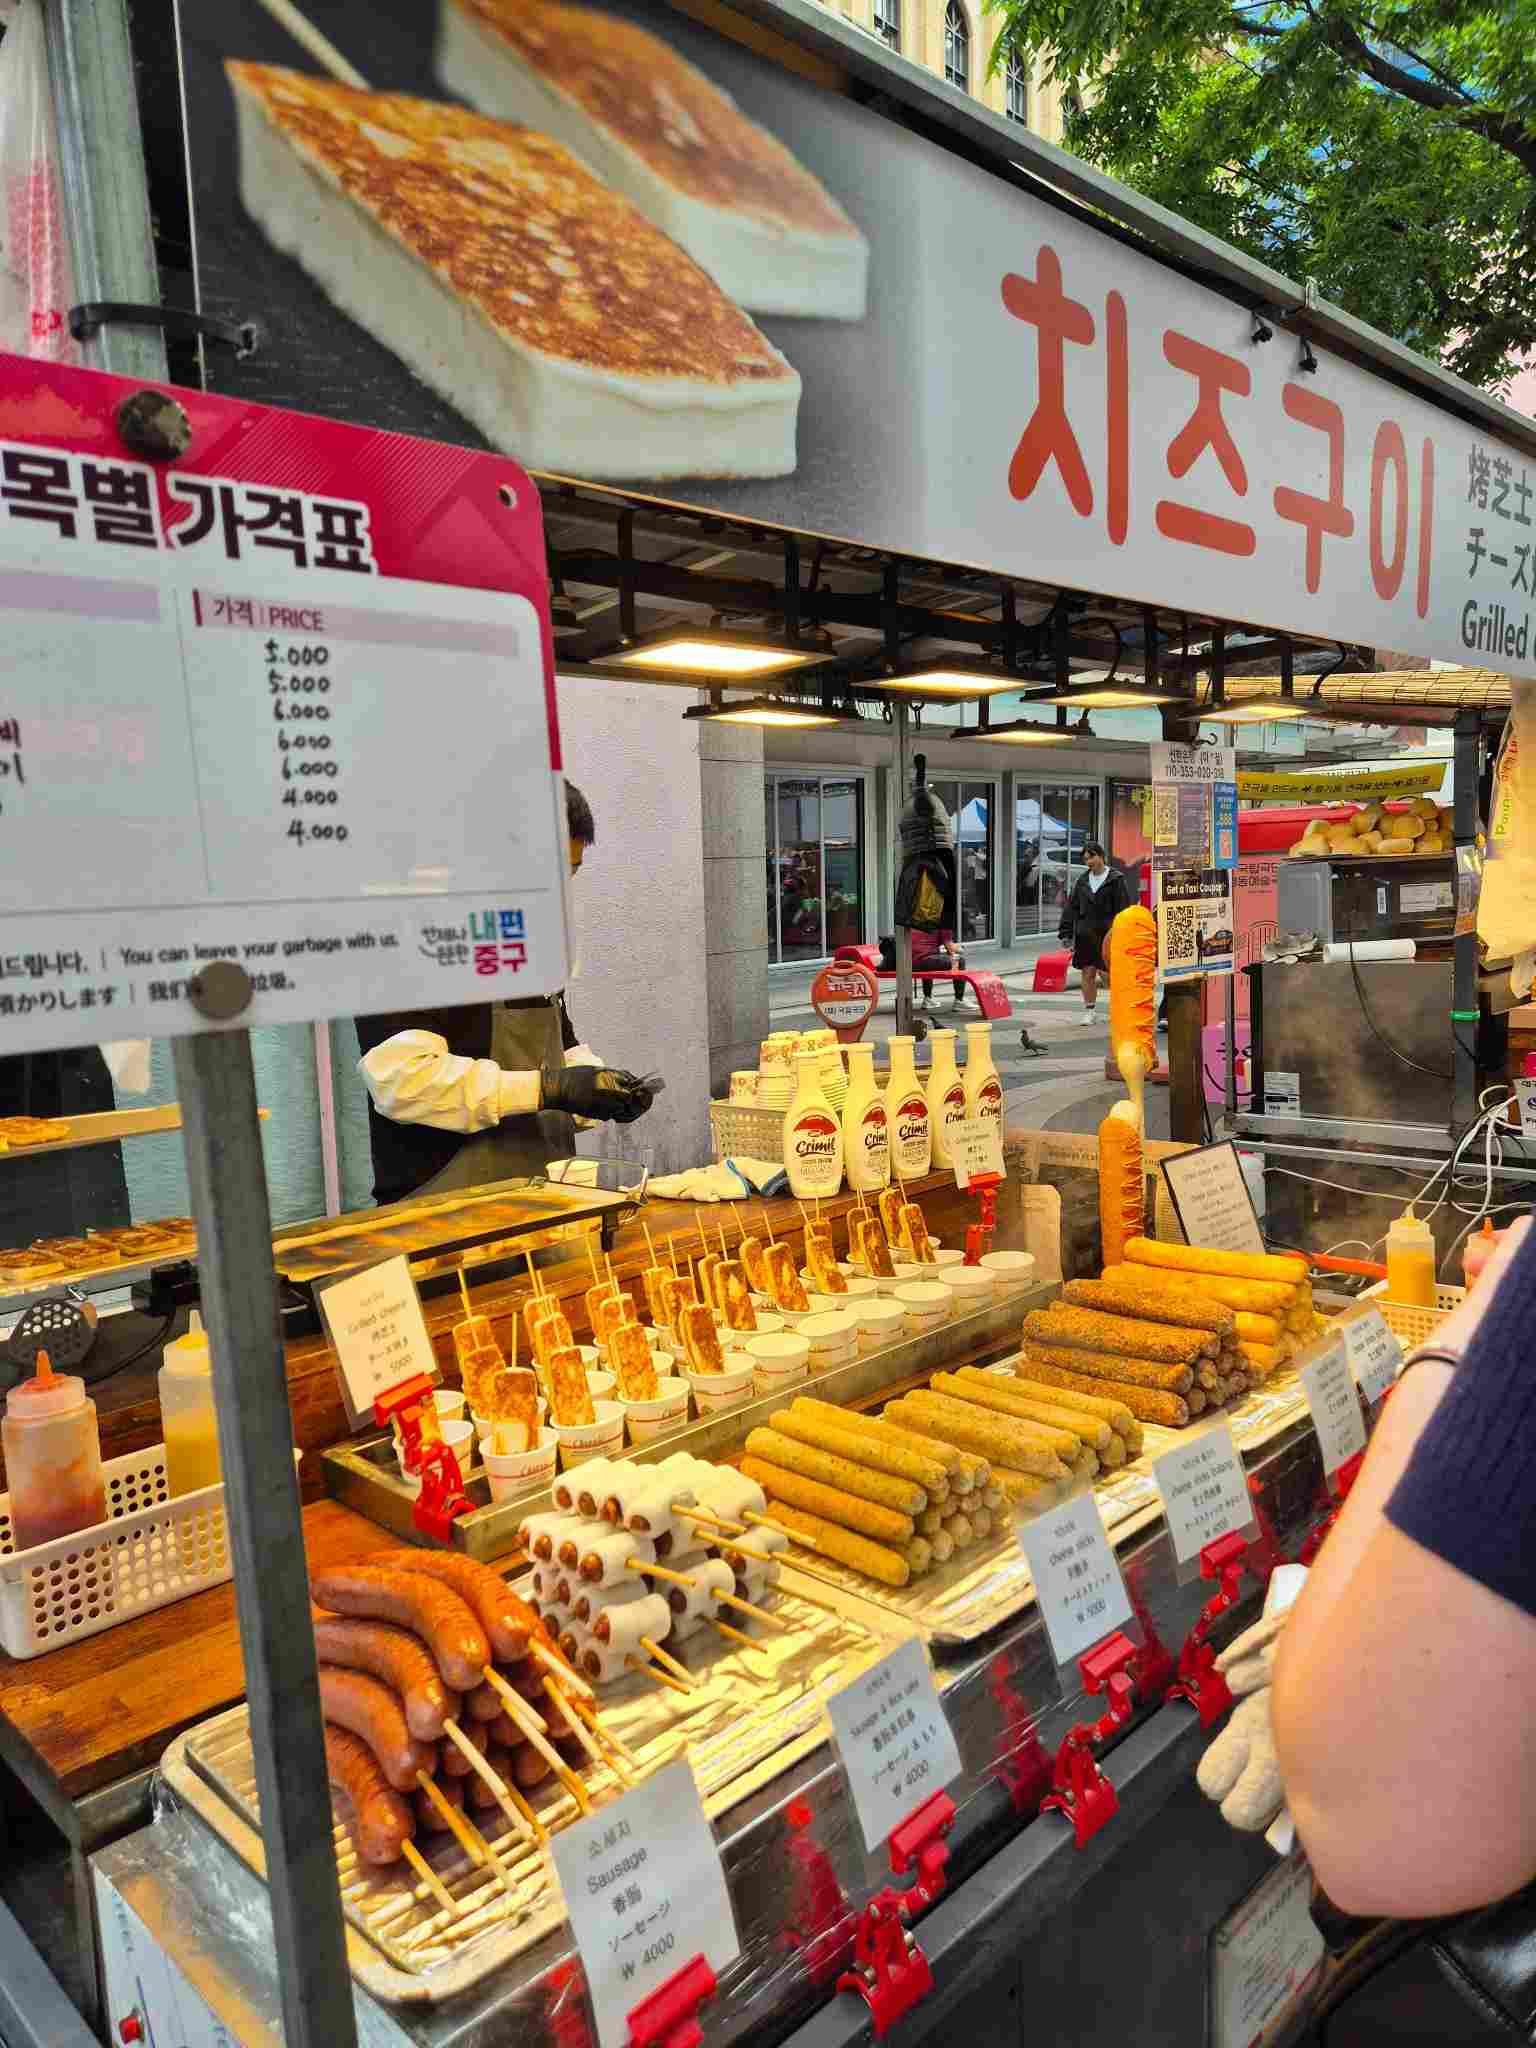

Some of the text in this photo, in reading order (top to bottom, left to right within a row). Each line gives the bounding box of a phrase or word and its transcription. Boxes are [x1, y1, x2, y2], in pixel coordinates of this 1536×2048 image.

[1000, 245, 1434, 618] 치즈구이
[1464, 443, 1533, 526] 烤芝士
[172, 478, 372, 576] 가격표
[1463, 527, 1536, 600] チーズ
[212, 597, 325, 632] 가격 PRICE
[1461, 599, 1530, 660] Grilled
[267, 669, 331, 694] 5.000
[282, 787, 339, 807] 4.000
[287, 819, 349, 848] 4.000
[0, 950, 88, 979] 드립니다.
[119, 946, 152, 965] You
[157, 947, 189, 963] can
[194, 943, 238, 962] leave
[242, 939, 279, 957] your
[282, 934, 343, 957] garbage
[345, 931, 376, 950] with
[587, 1847, 648, 1895] Sausage
[608, 1900, 671, 1953] ソーセージ
[641, 1932, 676, 1966] 4000
